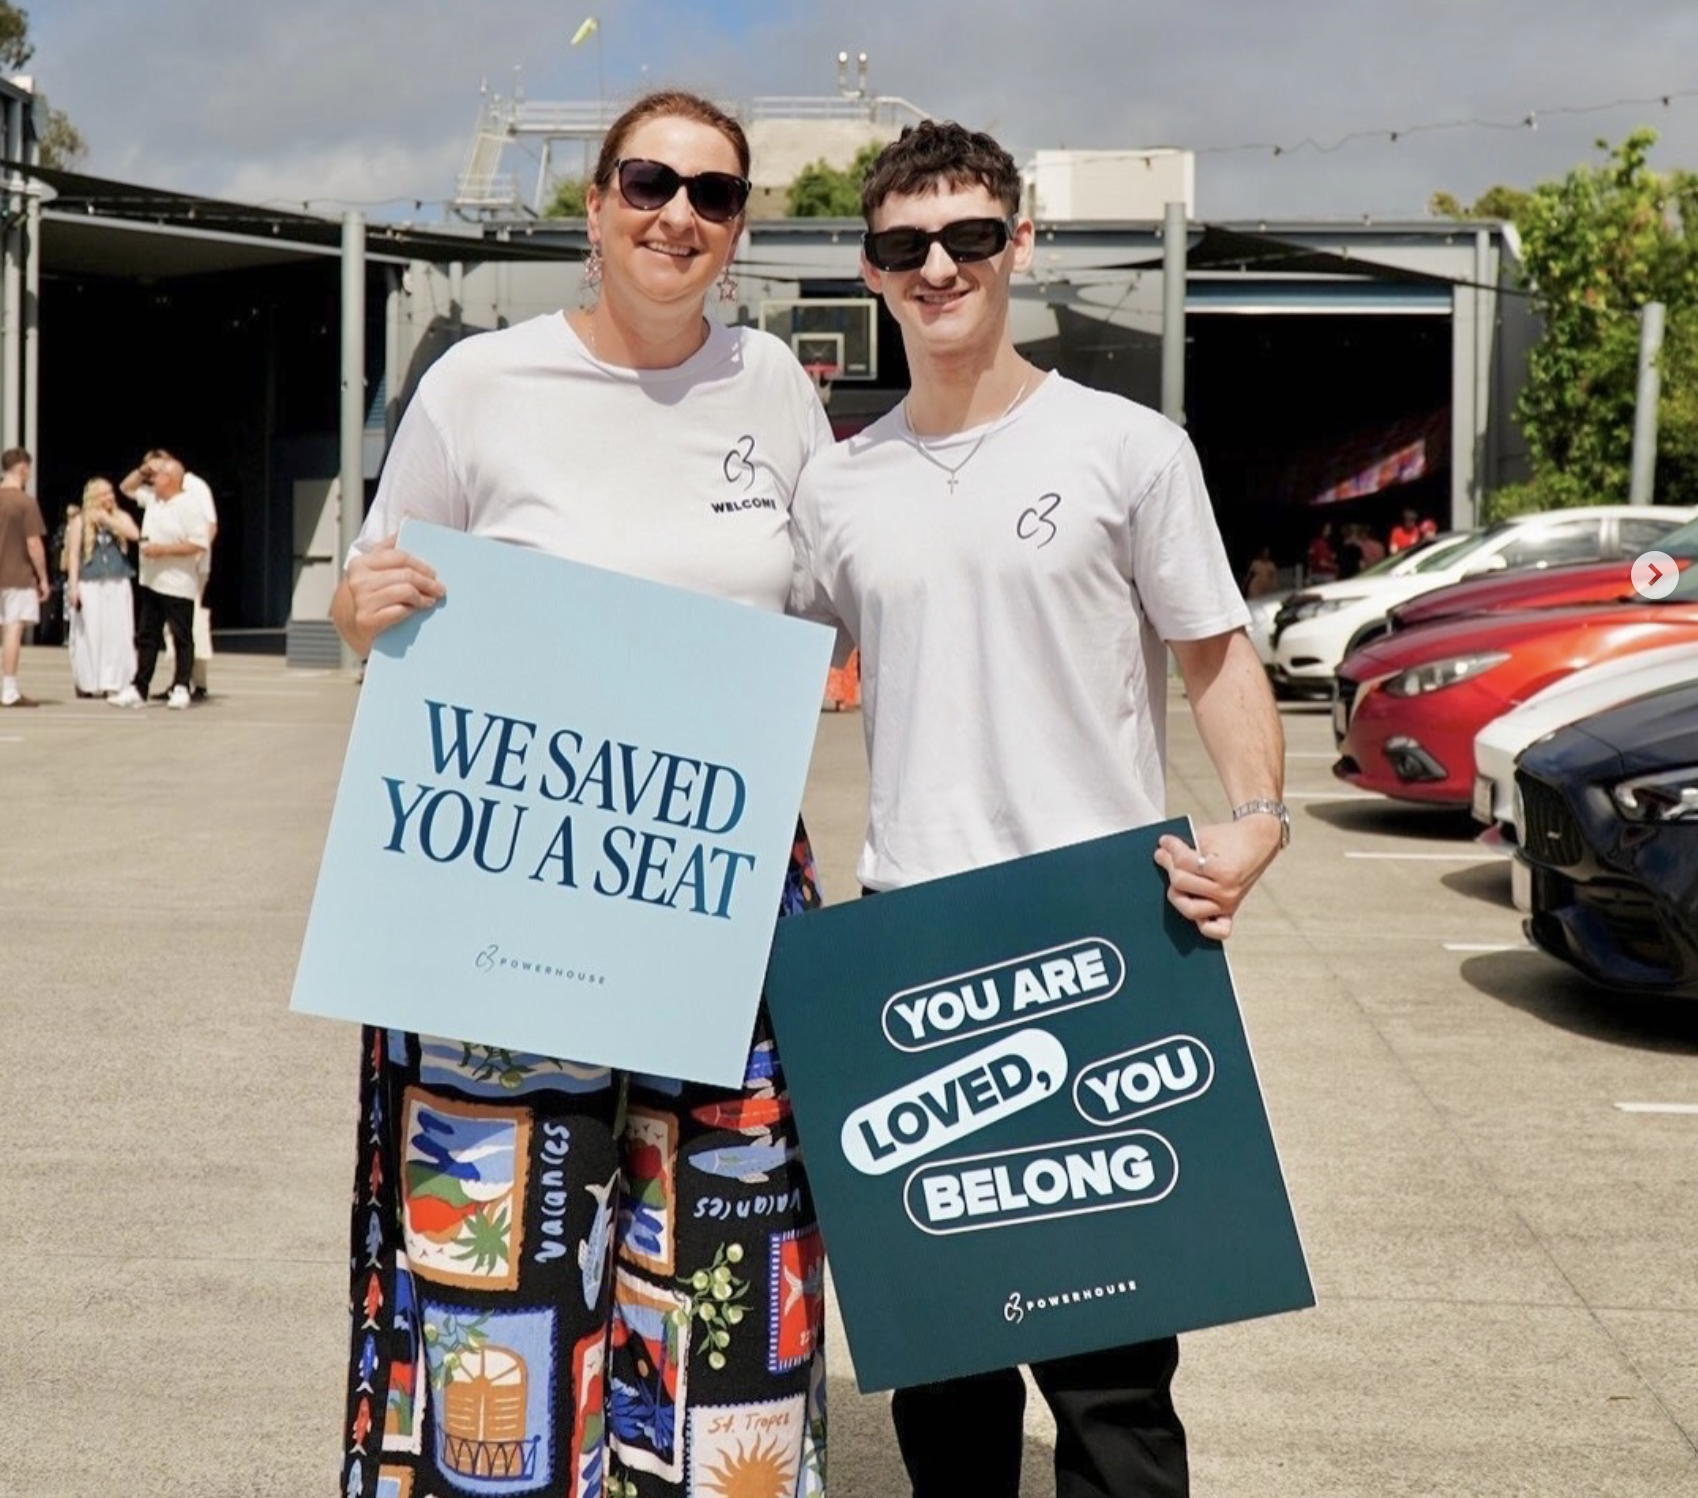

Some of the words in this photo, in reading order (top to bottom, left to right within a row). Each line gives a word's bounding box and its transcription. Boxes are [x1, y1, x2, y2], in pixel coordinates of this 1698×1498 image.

[424, 699, 537, 792] WE
[538, 729, 746, 834] SAVED
[381, 776, 529, 873] YOU
[528, 815, 578, 888] A
[593, 826, 756, 919] SEAT
[499, 957, 606, 985] POWERHOUSE
[893, 978, 1000, 1040] YOU
[1012, 947, 1110, 1011] ARE
[858, 1053, 1053, 1162] LOVED,
[1085, 1046, 1199, 1114] YOU
[921, 1144, 1156, 1222] BELONG
[1025, 1279, 1137, 1312] POWERHOUSE
